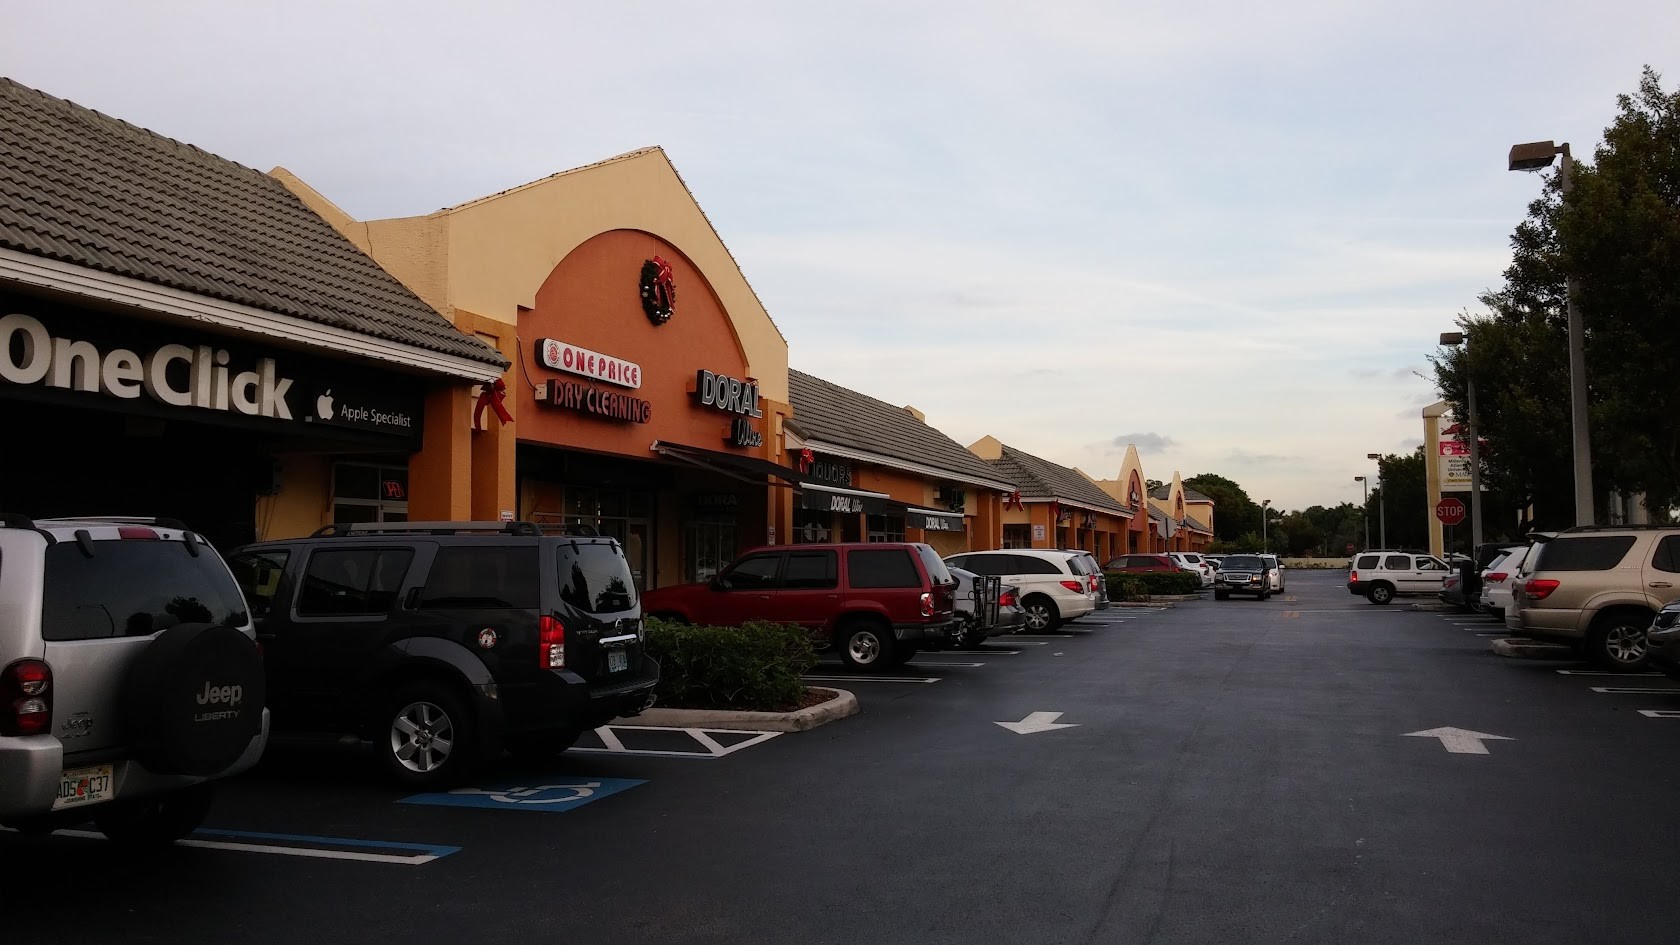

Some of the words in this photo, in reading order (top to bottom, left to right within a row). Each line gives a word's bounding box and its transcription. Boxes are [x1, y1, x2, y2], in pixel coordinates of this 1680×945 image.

[0, 313, 294, 420] OneClick
[563, 347, 594, 374] ONE
[598, 357, 637, 386] PRICE
[553, 379, 583, 410] DRY
[586, 387, 652, 424] CLEANING
[701, 369, 763, 419] DORAL
[340, 404, 369, 422] Apple
[370, 408, 411, 427] Specialist
[736, 418, 763, 448] Wine
[810, 460, 852, 485] IQUORS
[830, 495, 851, 514] DORAL
[1437, 506, 1464, 517] STOP
[196, 681, 242, 706] Jeep
[194, 709, 241, 722] LIBERTY
[89, 775, 109, 794] C37
